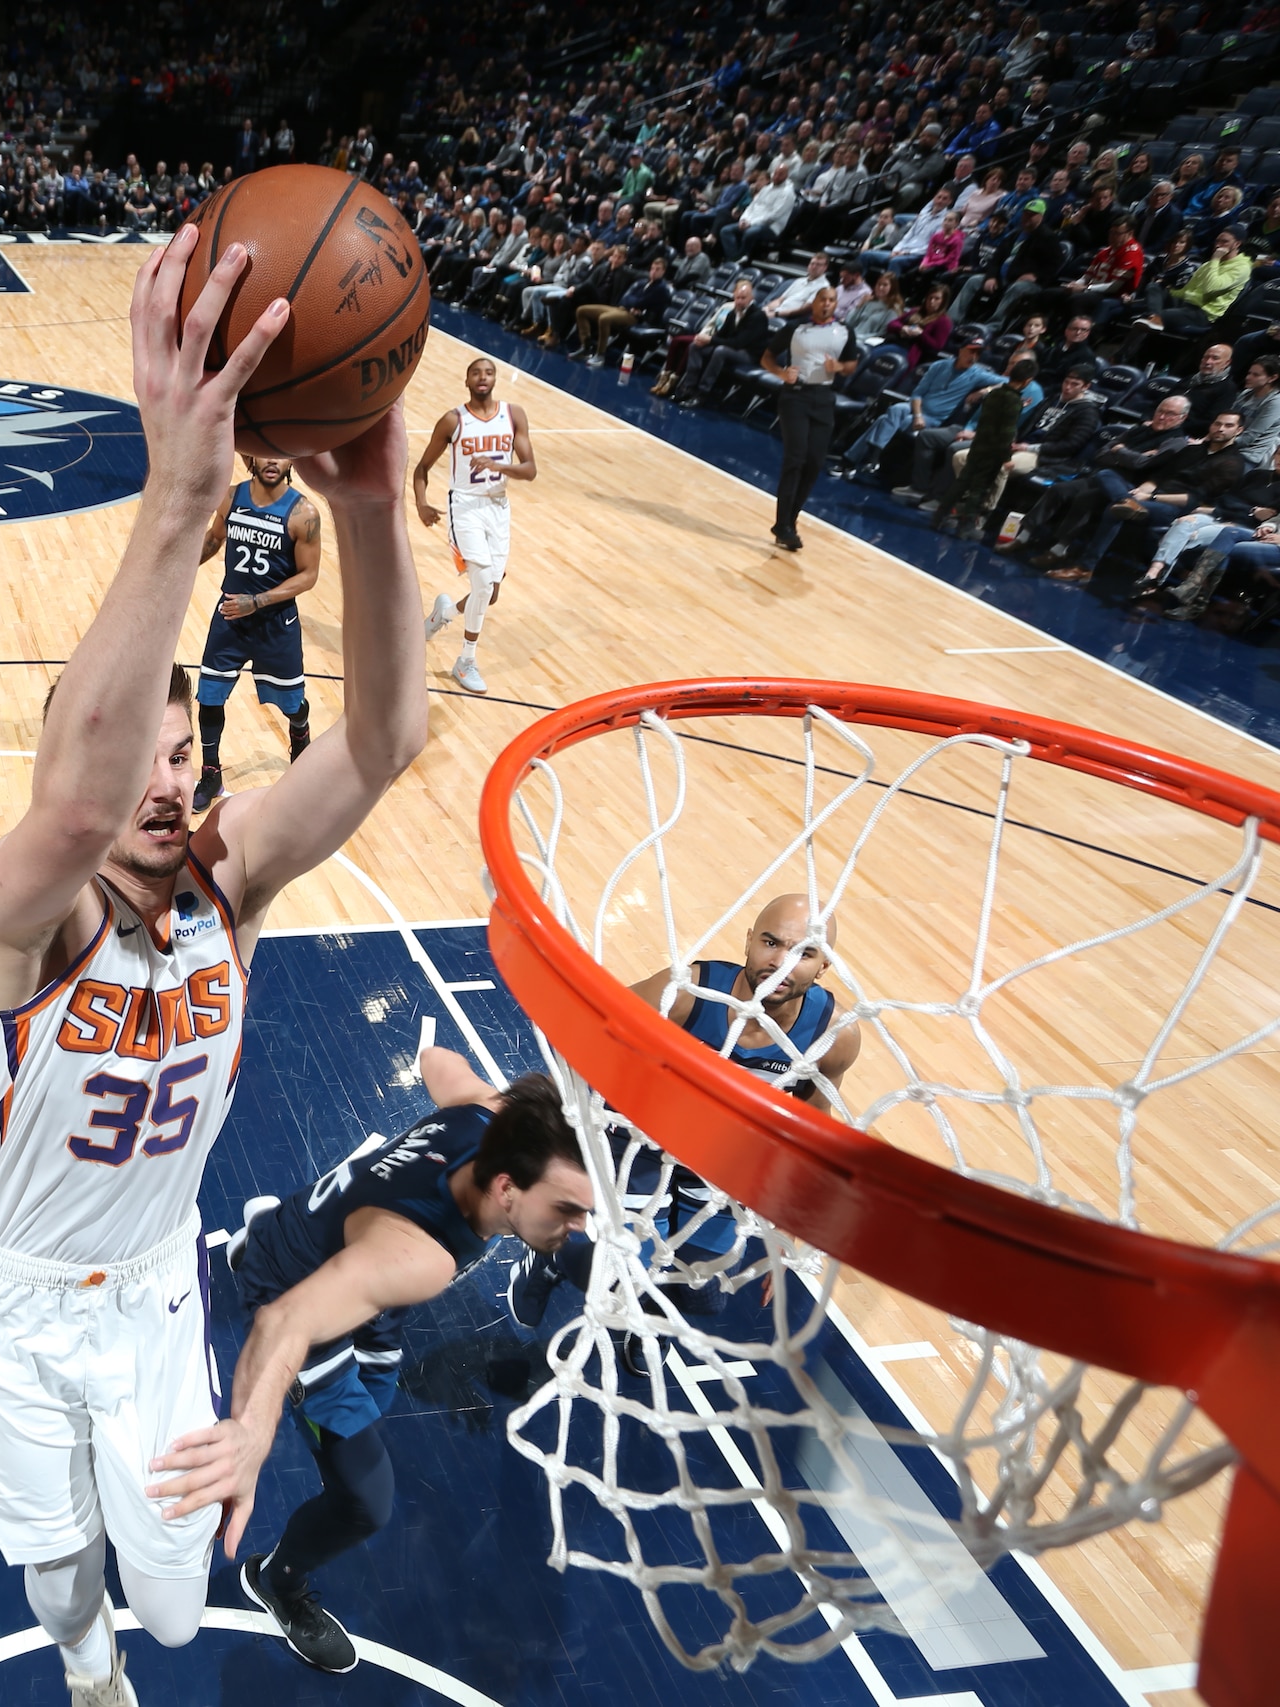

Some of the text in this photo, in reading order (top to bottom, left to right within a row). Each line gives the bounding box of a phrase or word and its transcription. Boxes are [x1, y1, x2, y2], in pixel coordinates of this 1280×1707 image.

[461, 433, 512, 456] SUNS
[227, 524, 282, 550] MINNESOTA
[233, 545, 270, 576] 25
[174, 915, 216, 941] PayPal
[56, 960, 231, 1062] SUNS
[66, 1053, 209, 1168] 35
